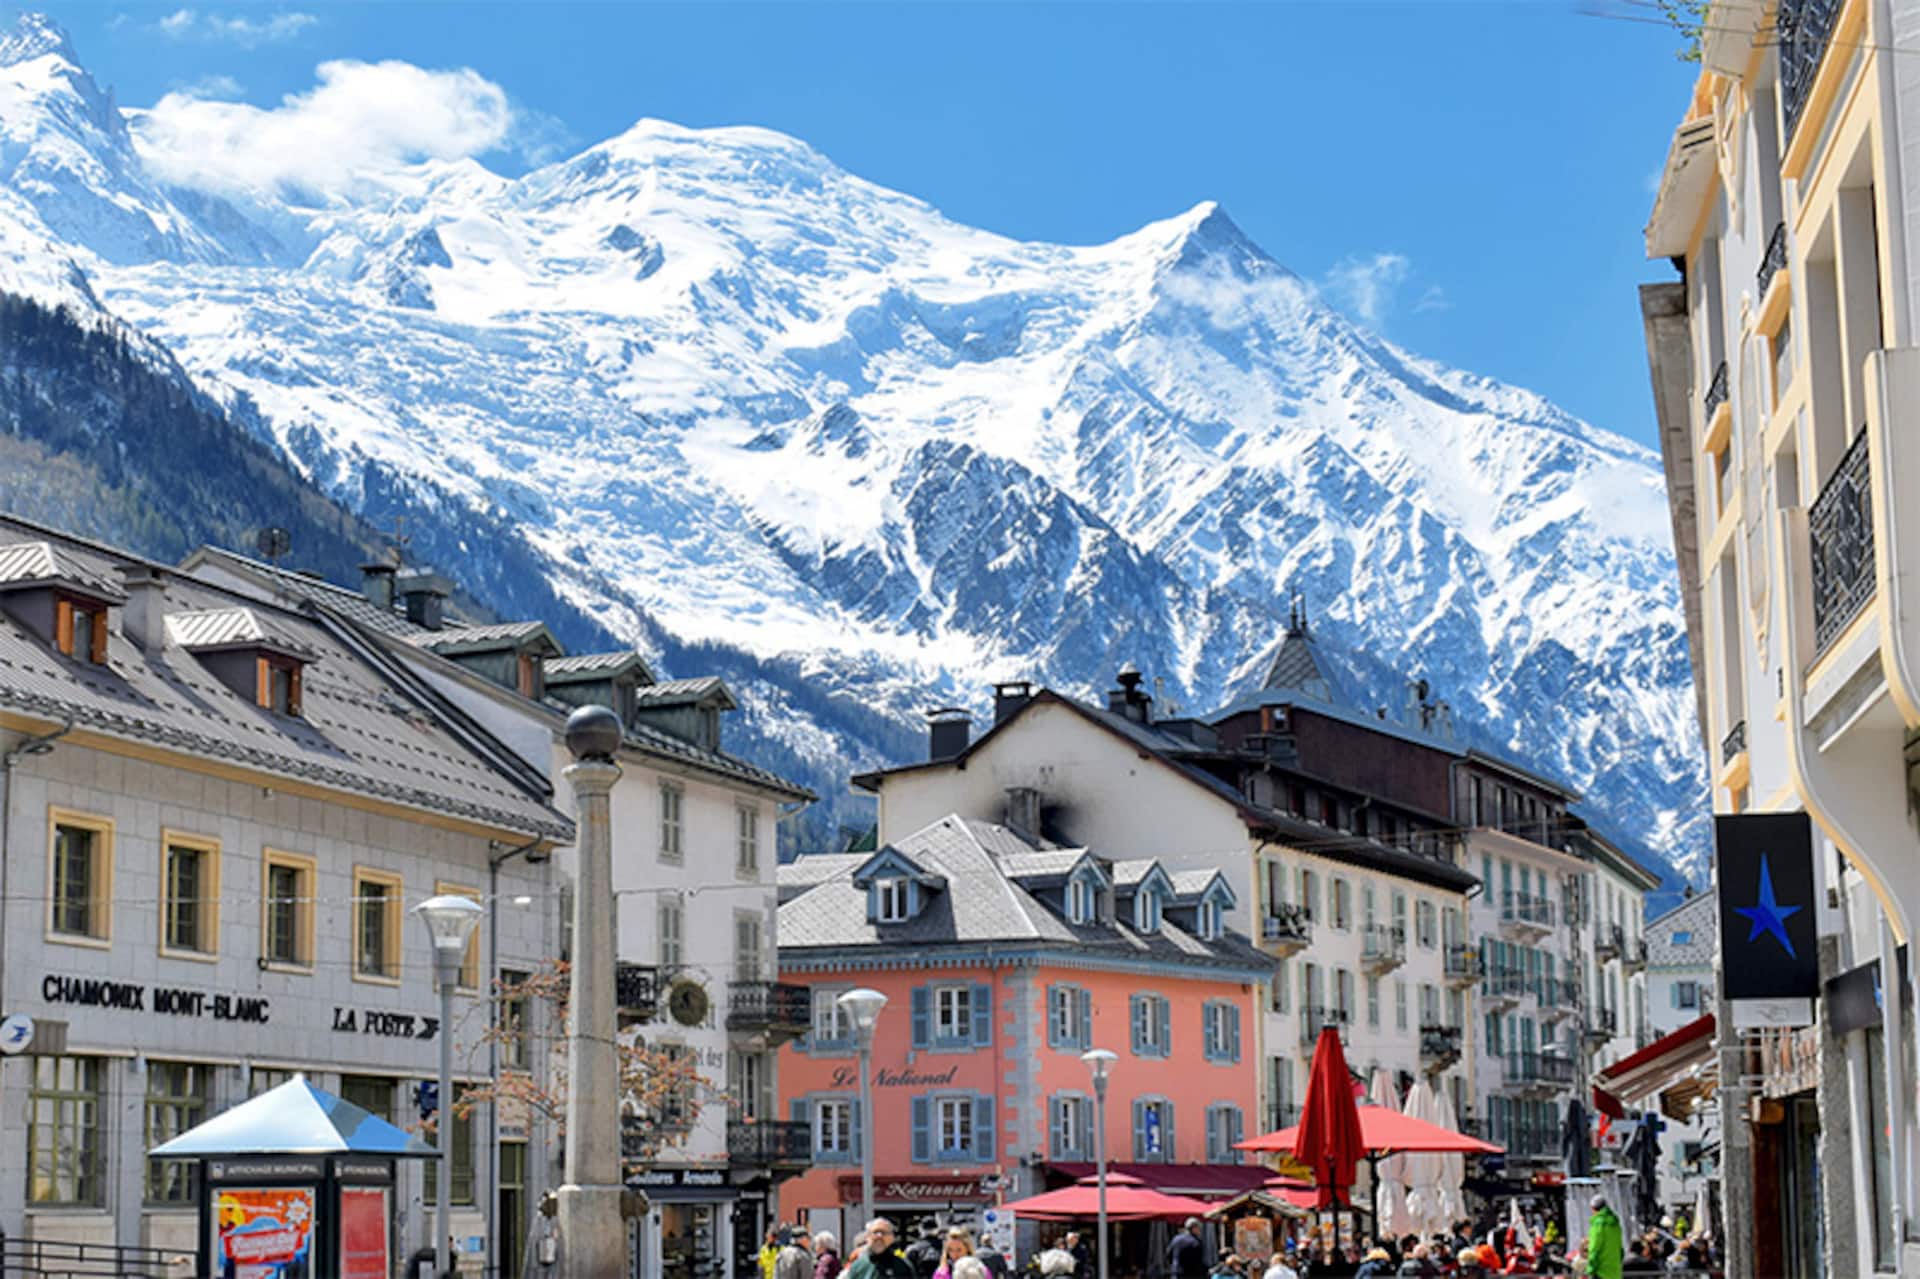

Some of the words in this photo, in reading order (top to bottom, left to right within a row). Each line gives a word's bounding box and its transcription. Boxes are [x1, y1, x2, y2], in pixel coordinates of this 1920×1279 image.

[42, 975, 144, 1011] CHAMONIX
[153, 988, 269, 1024] MONT-BLANC
[331, 1007, 357, 1032] LA
[363, 1010, 416, 1038] POSTE
[830, 1065, 857, 1088] Le
[871, 1065, 958, 1088] National
[885, 1182, 974, 1200] National
